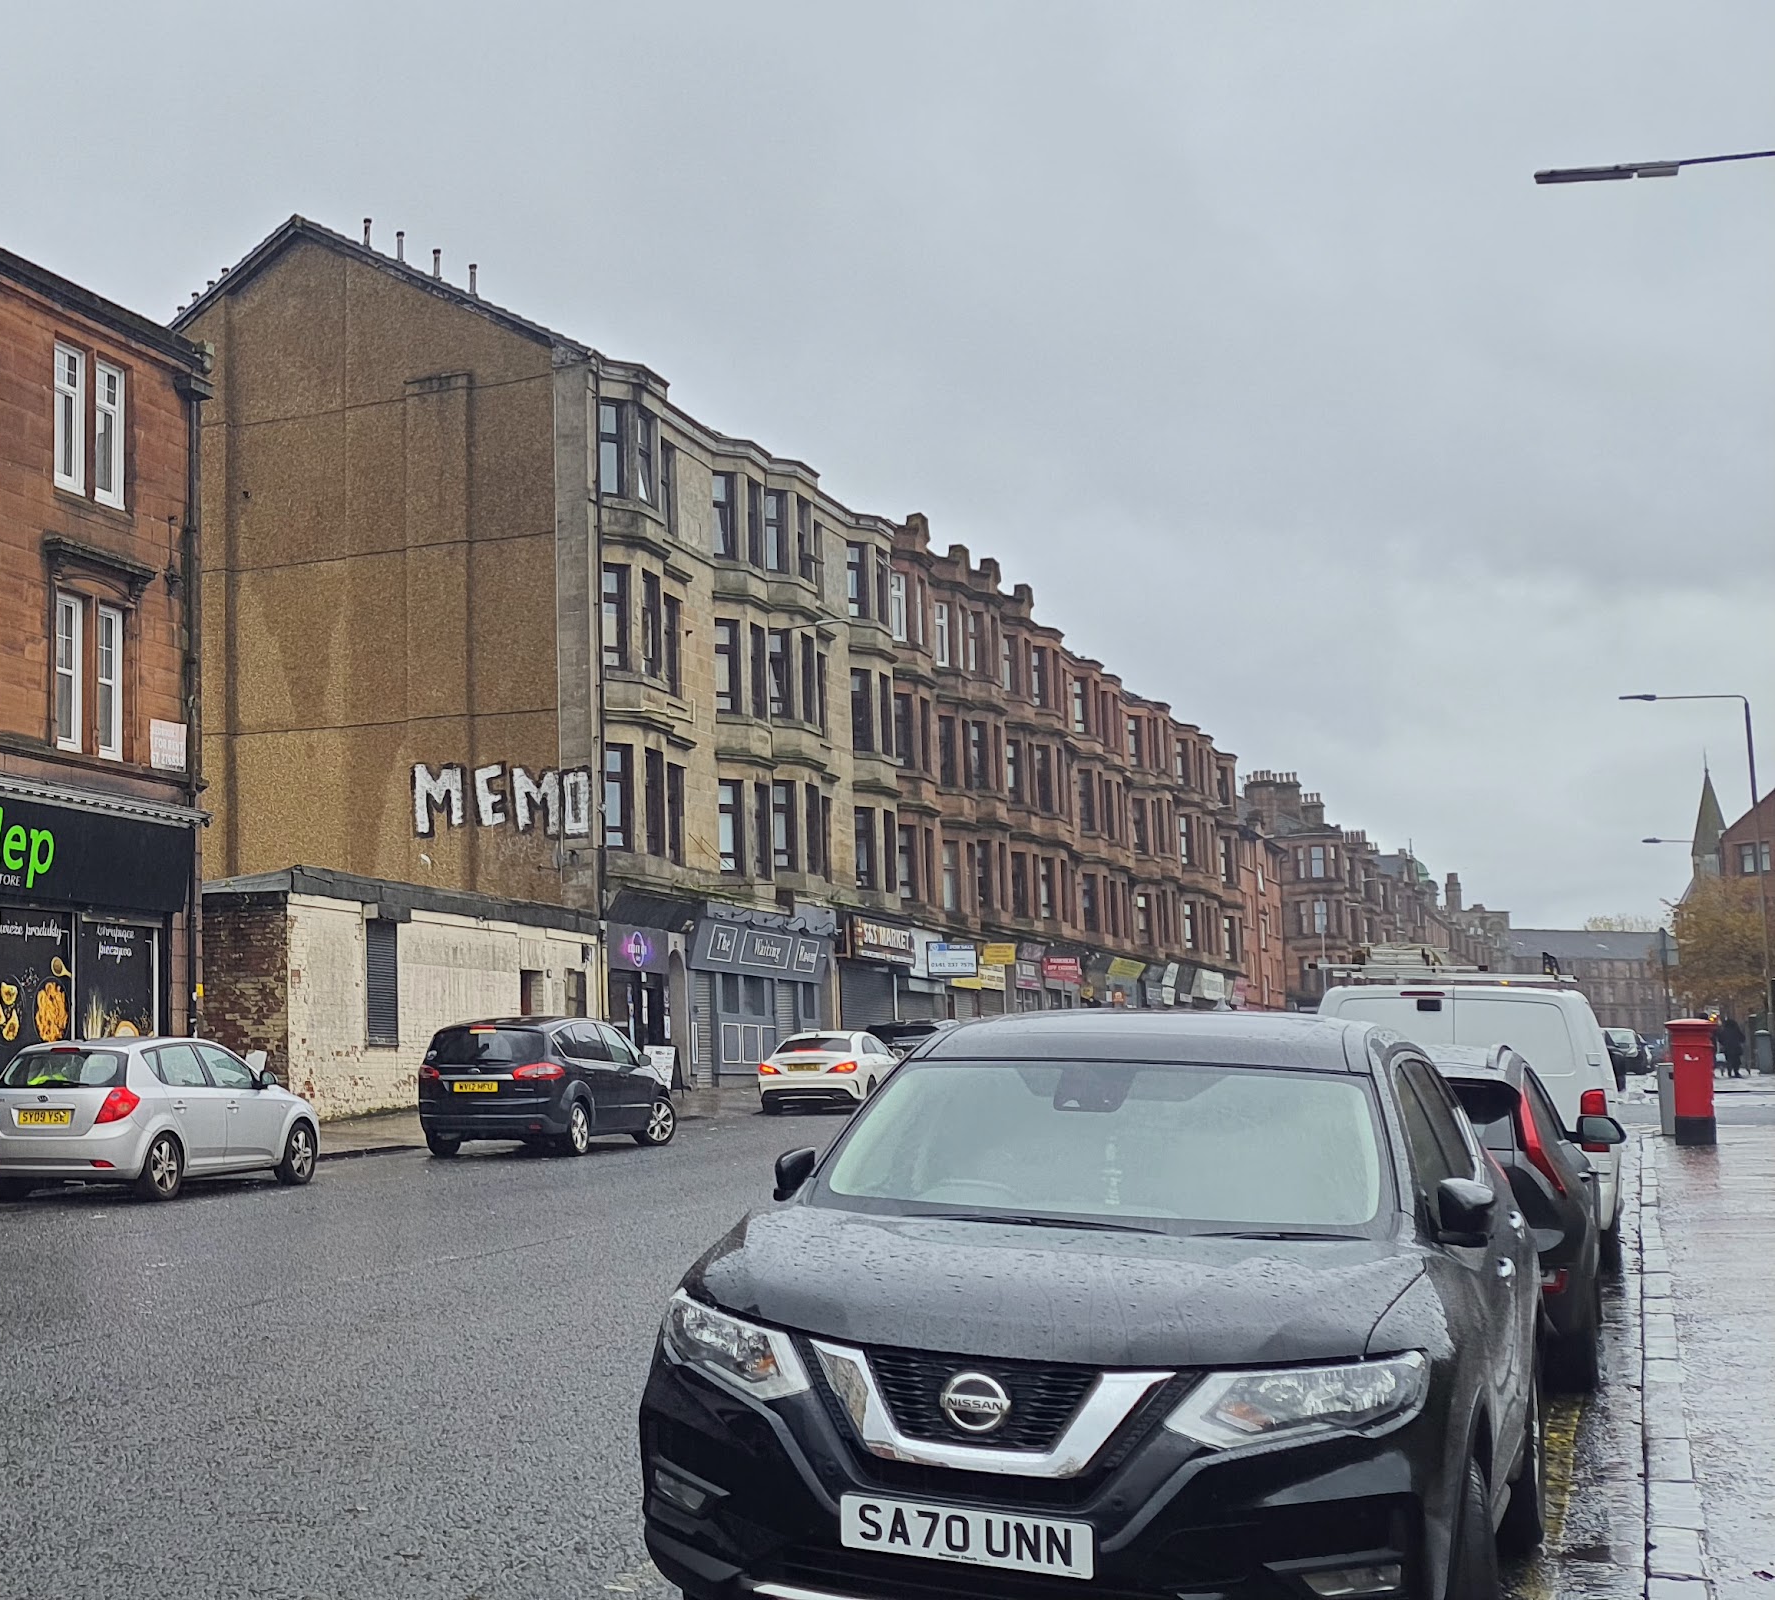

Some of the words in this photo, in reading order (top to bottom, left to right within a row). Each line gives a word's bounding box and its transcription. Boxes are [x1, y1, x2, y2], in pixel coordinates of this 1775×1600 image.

[412, 762, 591, 836] MEMO
[716, 932, 731, 952] The
[754, 937, 782, 963] Waiting
[878, 925, 910, 951] MARKET
[22, 1111, 45, 1123] SY09
[947, 1397, 1004, 1411] NISSAN
[858, 1503, 970, 1553] SA70
[985, 1518, 1073, 1568] UNN
